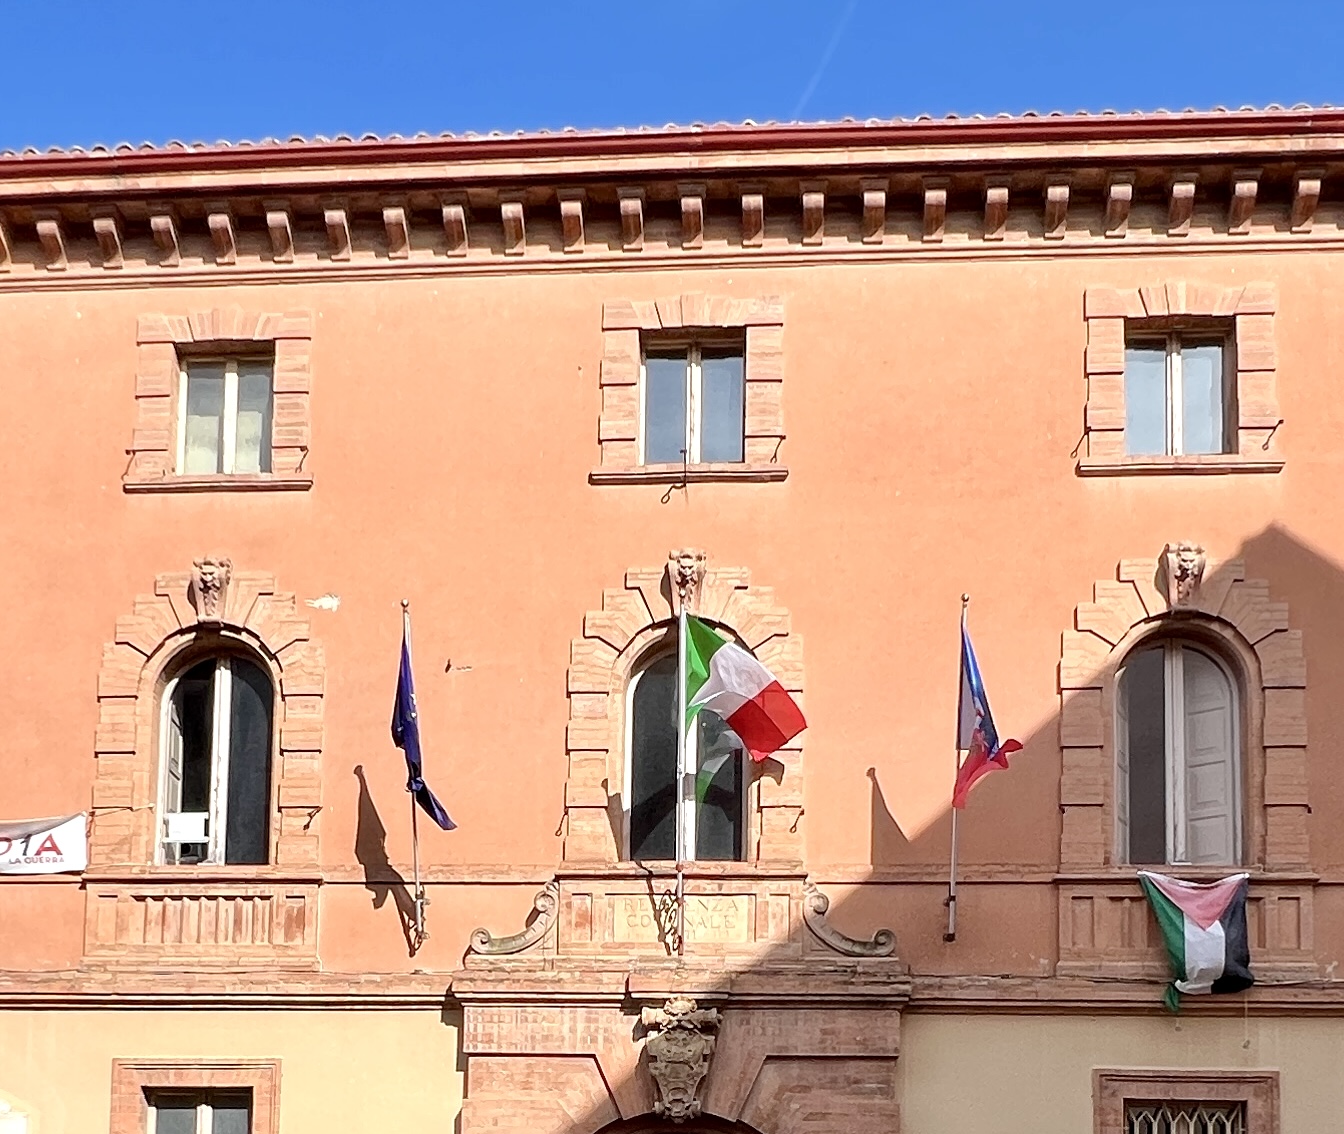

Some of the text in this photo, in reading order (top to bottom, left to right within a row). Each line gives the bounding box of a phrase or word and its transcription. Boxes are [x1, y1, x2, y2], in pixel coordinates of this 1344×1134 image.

[8, 857, 22, 865] LA
[624, 899, 739, 912] REENZA
[626, 914, 736, 928] CONALE
